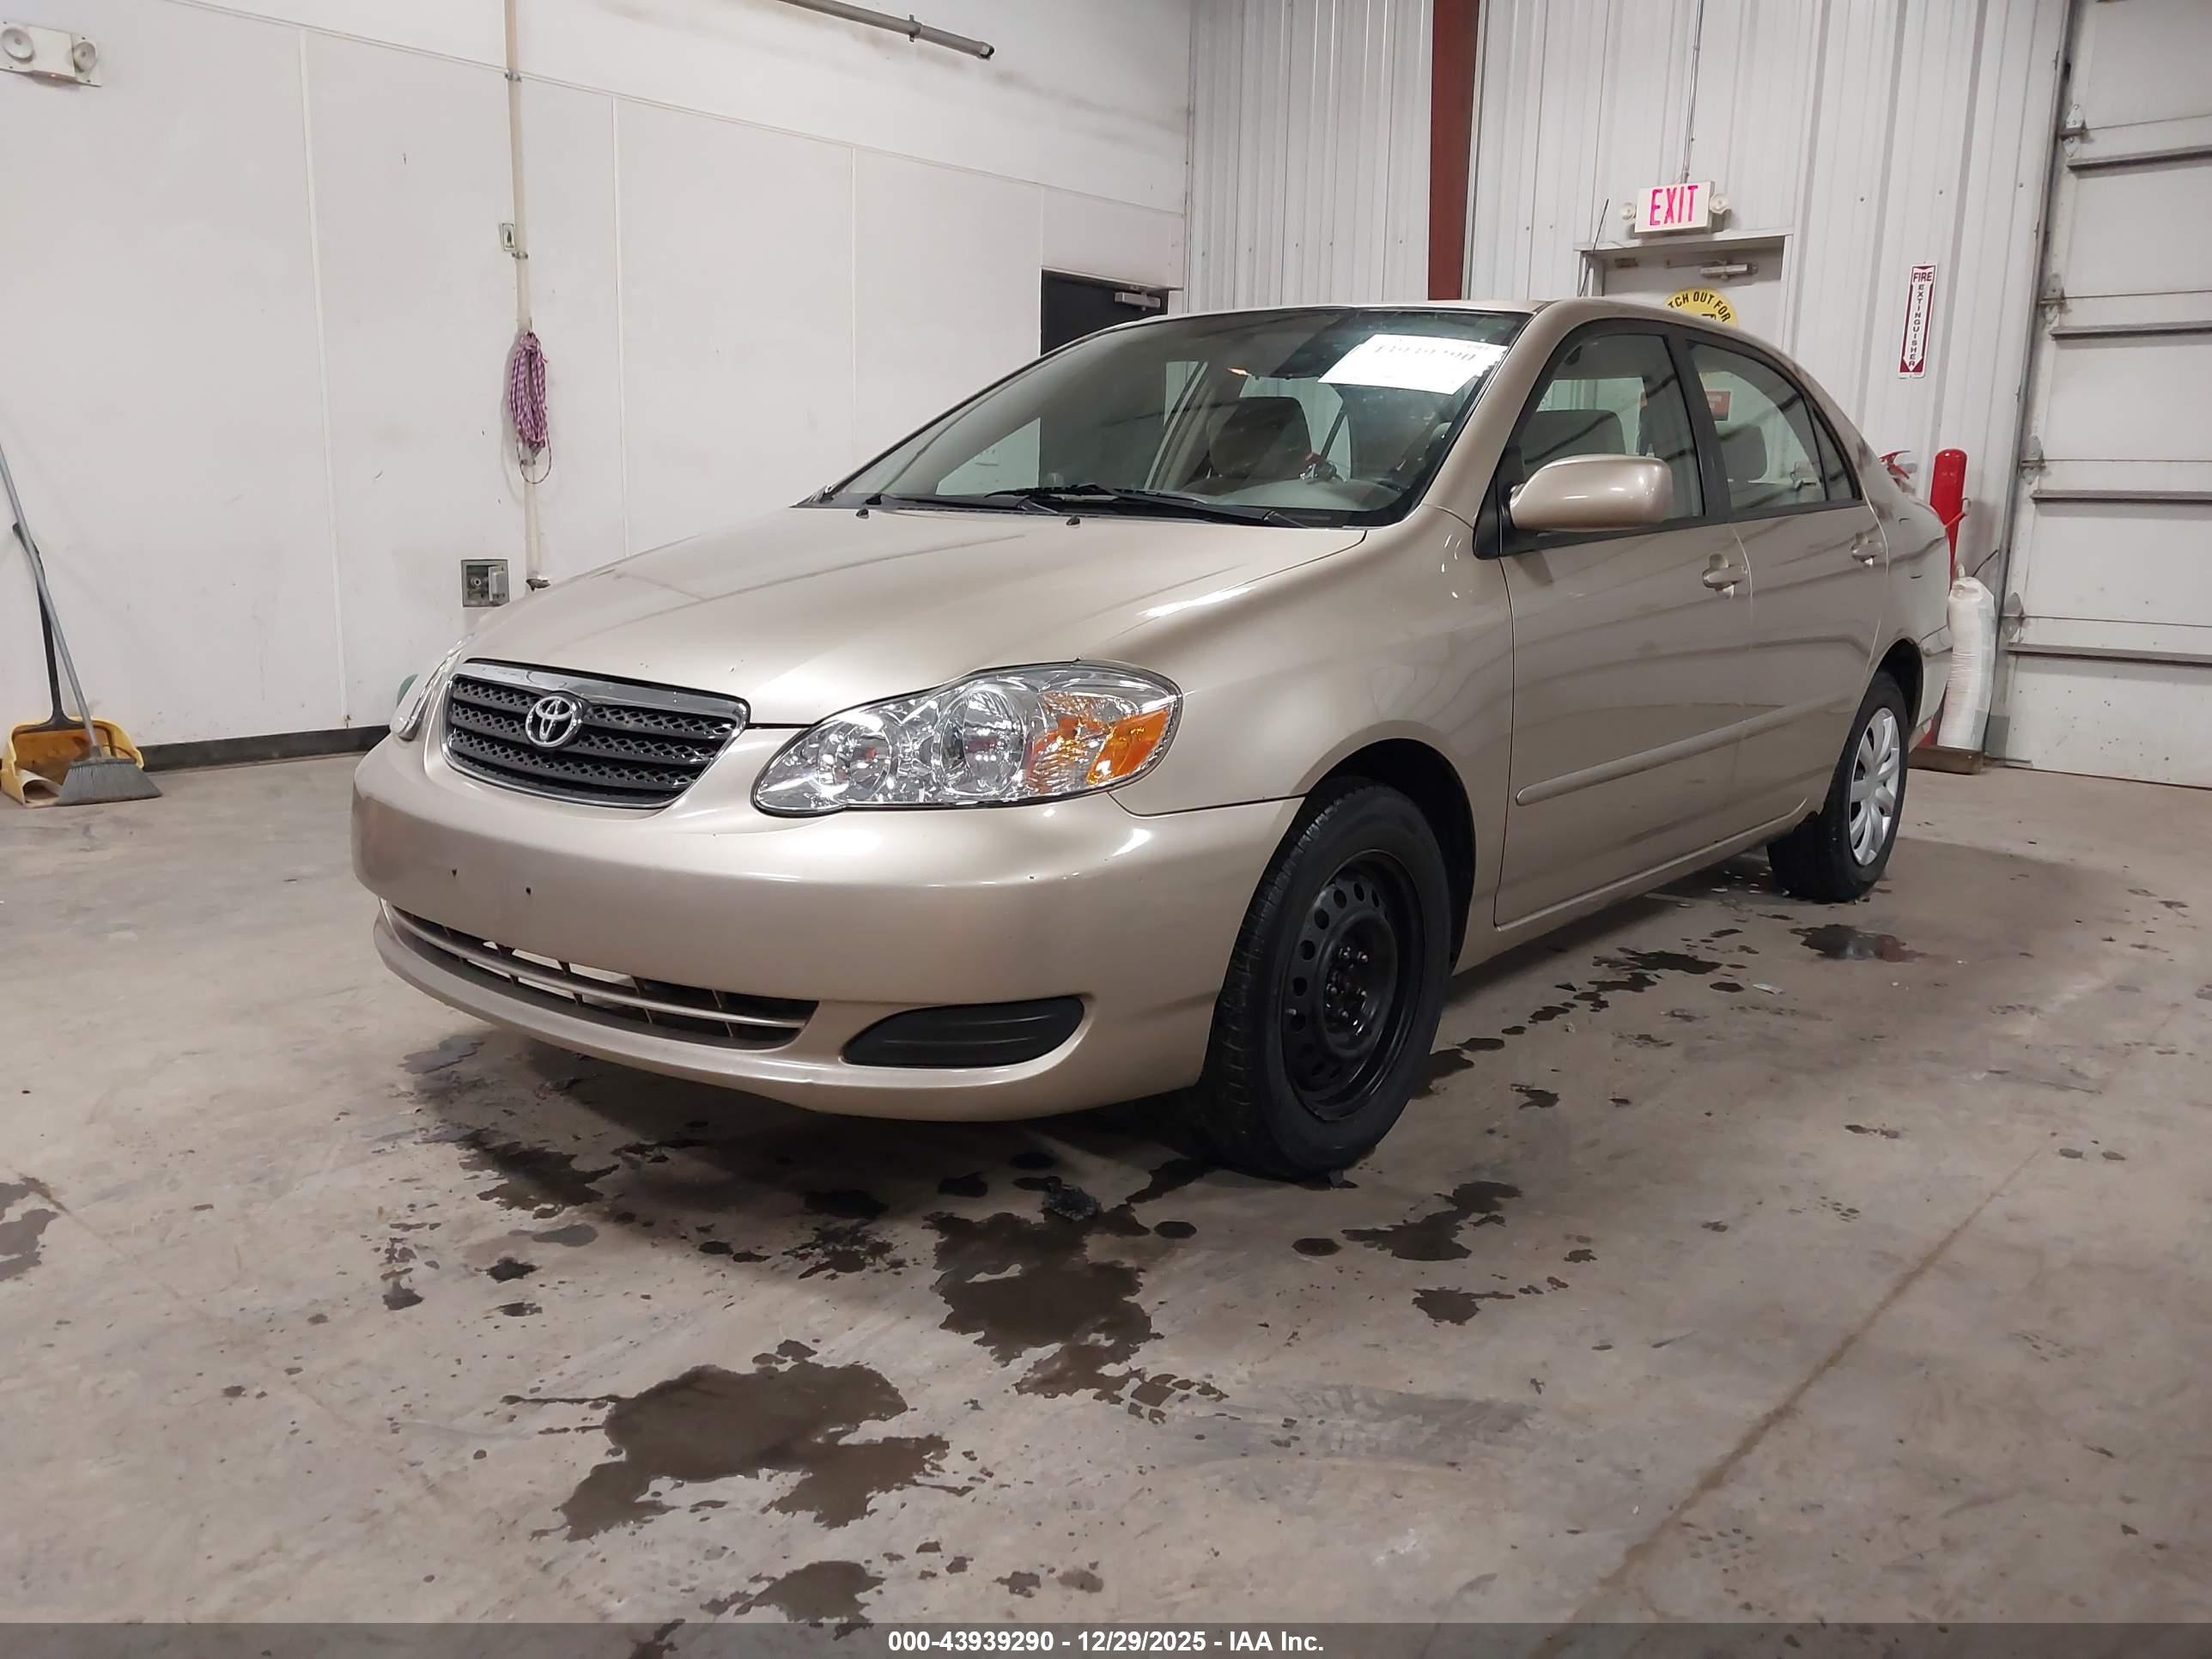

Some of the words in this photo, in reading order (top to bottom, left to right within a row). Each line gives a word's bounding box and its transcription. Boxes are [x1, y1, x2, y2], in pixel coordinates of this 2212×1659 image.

[1649, 185, 1698, 227] EXIT
[1912, 272, 1933, 283] FIRE
[1668, 293, 1690, 309] TCH
[1692, 291, 1715, 305] OUT
[1713, 300, 1731, 323] FOR
[1908, 283, 1925, 368] EXTINGUISHER
